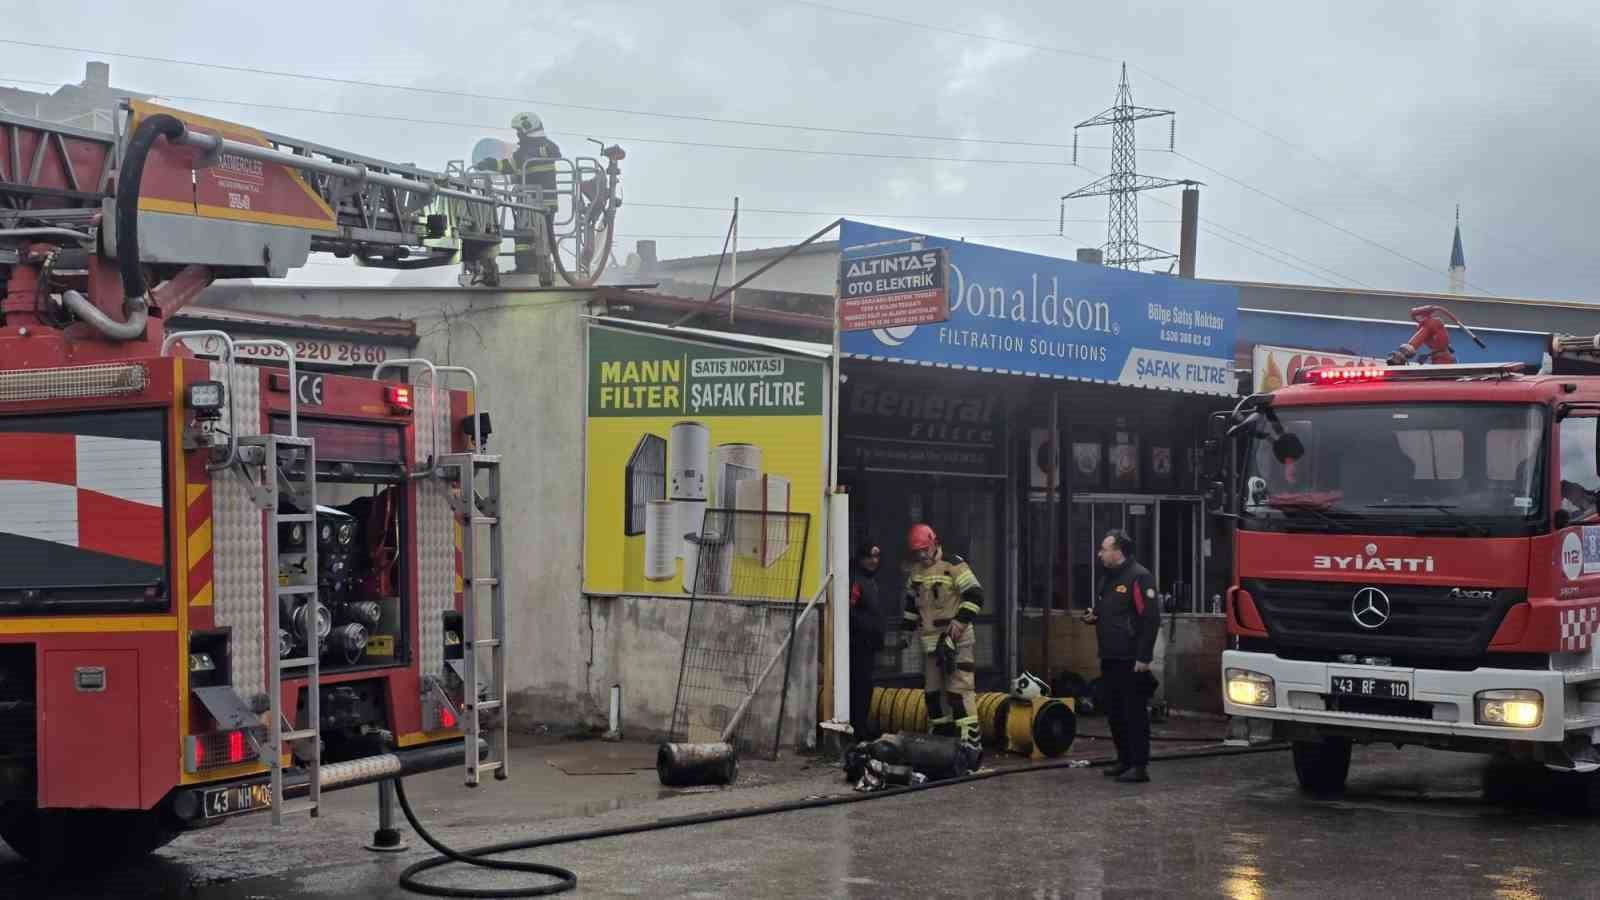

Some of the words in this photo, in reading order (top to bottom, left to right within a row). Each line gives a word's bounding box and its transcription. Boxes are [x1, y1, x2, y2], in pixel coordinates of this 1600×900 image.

[846, 252, 936, 278] ALTINTAŞ
[848, 281, 873, 295] OTO
[876, 271, 934, 292] ELEKTRİK
[295, 341, 332, 360] 220
[939, 327, 1024, 353] FILTRATION
[1030, 338, 1107, 362] SOLUTIONS
[600, 359, 680, 384] MANN
[695, 361, 727, 375] SATIŞ
[730, 359, 782, 374] NOKTASI
[1136, 357, 1181, 380] ŞAFAK
[600, 385, 680, 409] FILTER
[691, 383, 745, 413] ŞAFAK
[1339, 679, 1353, 693] 43
[1361, 680, 1376, 695] RF
[1390, 682, 1407, 697] 110
[213, 790, 229, 813] 43
